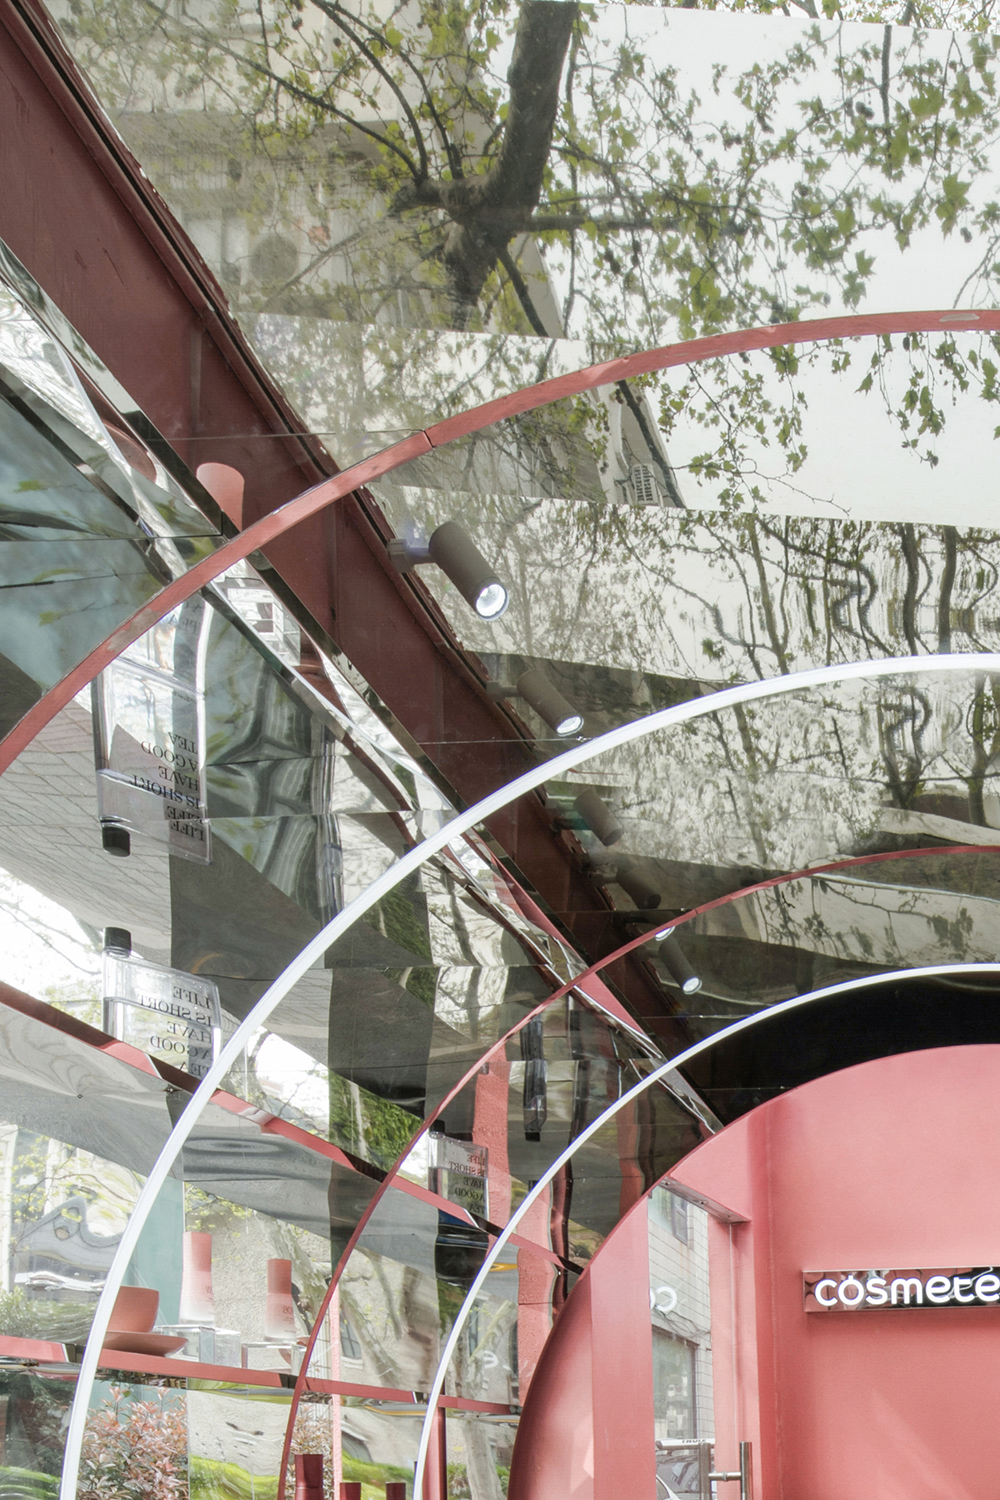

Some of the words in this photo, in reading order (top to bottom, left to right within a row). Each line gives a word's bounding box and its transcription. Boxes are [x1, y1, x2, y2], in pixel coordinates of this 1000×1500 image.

[141, 740, 189, 768] GOOD
[168, 731, 198, 754] TEA
[188, 758, 199, 772] A
[131, 774, 183, 804] SHORT
[158, 765, 200, 791] HAVE
[184, 793, 200, 811] IS
[170, 820, 204, 842] LIFE
